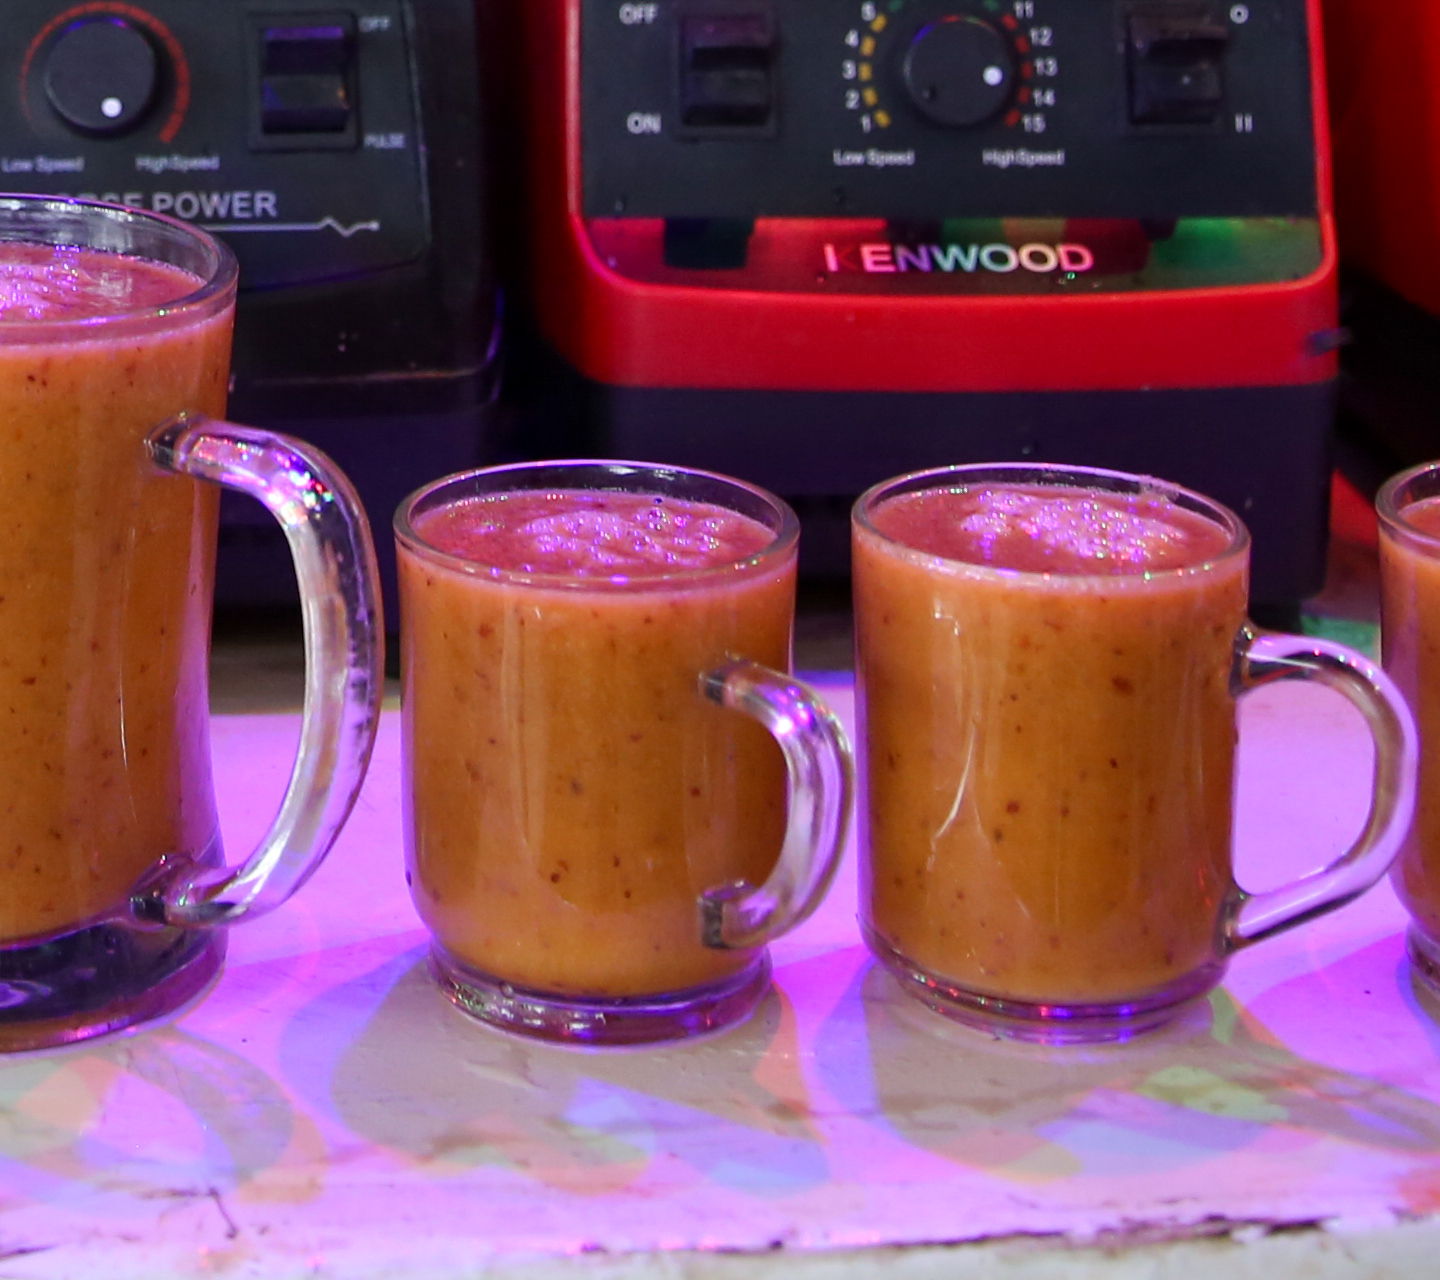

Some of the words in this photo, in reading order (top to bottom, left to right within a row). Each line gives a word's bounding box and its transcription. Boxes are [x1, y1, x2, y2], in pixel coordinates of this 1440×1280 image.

[619, 2, 659, 24] OFF
[861, 0, 876, 21] 5
[1014, 0, 1034, 19] 11
[357, 17, 391, 33] OFF
[844, 29, 859, 48] 4
[1030, 26, 1052, 46] 12
[842, 59, 857, 79] 3
[1034, 56, 1058, 77] 13
[845, 89, 860, 109] 2
[1033, 88, 1055, 107] 14
[627, 112, 661, 134] ON
[861, 114, 871, 133] 1
[1023, 112, 1046, 133] 15
[0, 157, 32, 172] Low
[34, 155, 84, 174] Speed
[833, 149, 865, 167] Low
[866, 148, 915, 168] Speed
[152, 191, 277, 219] POWER
[824, 243, 1094, 272] KENWOOD
